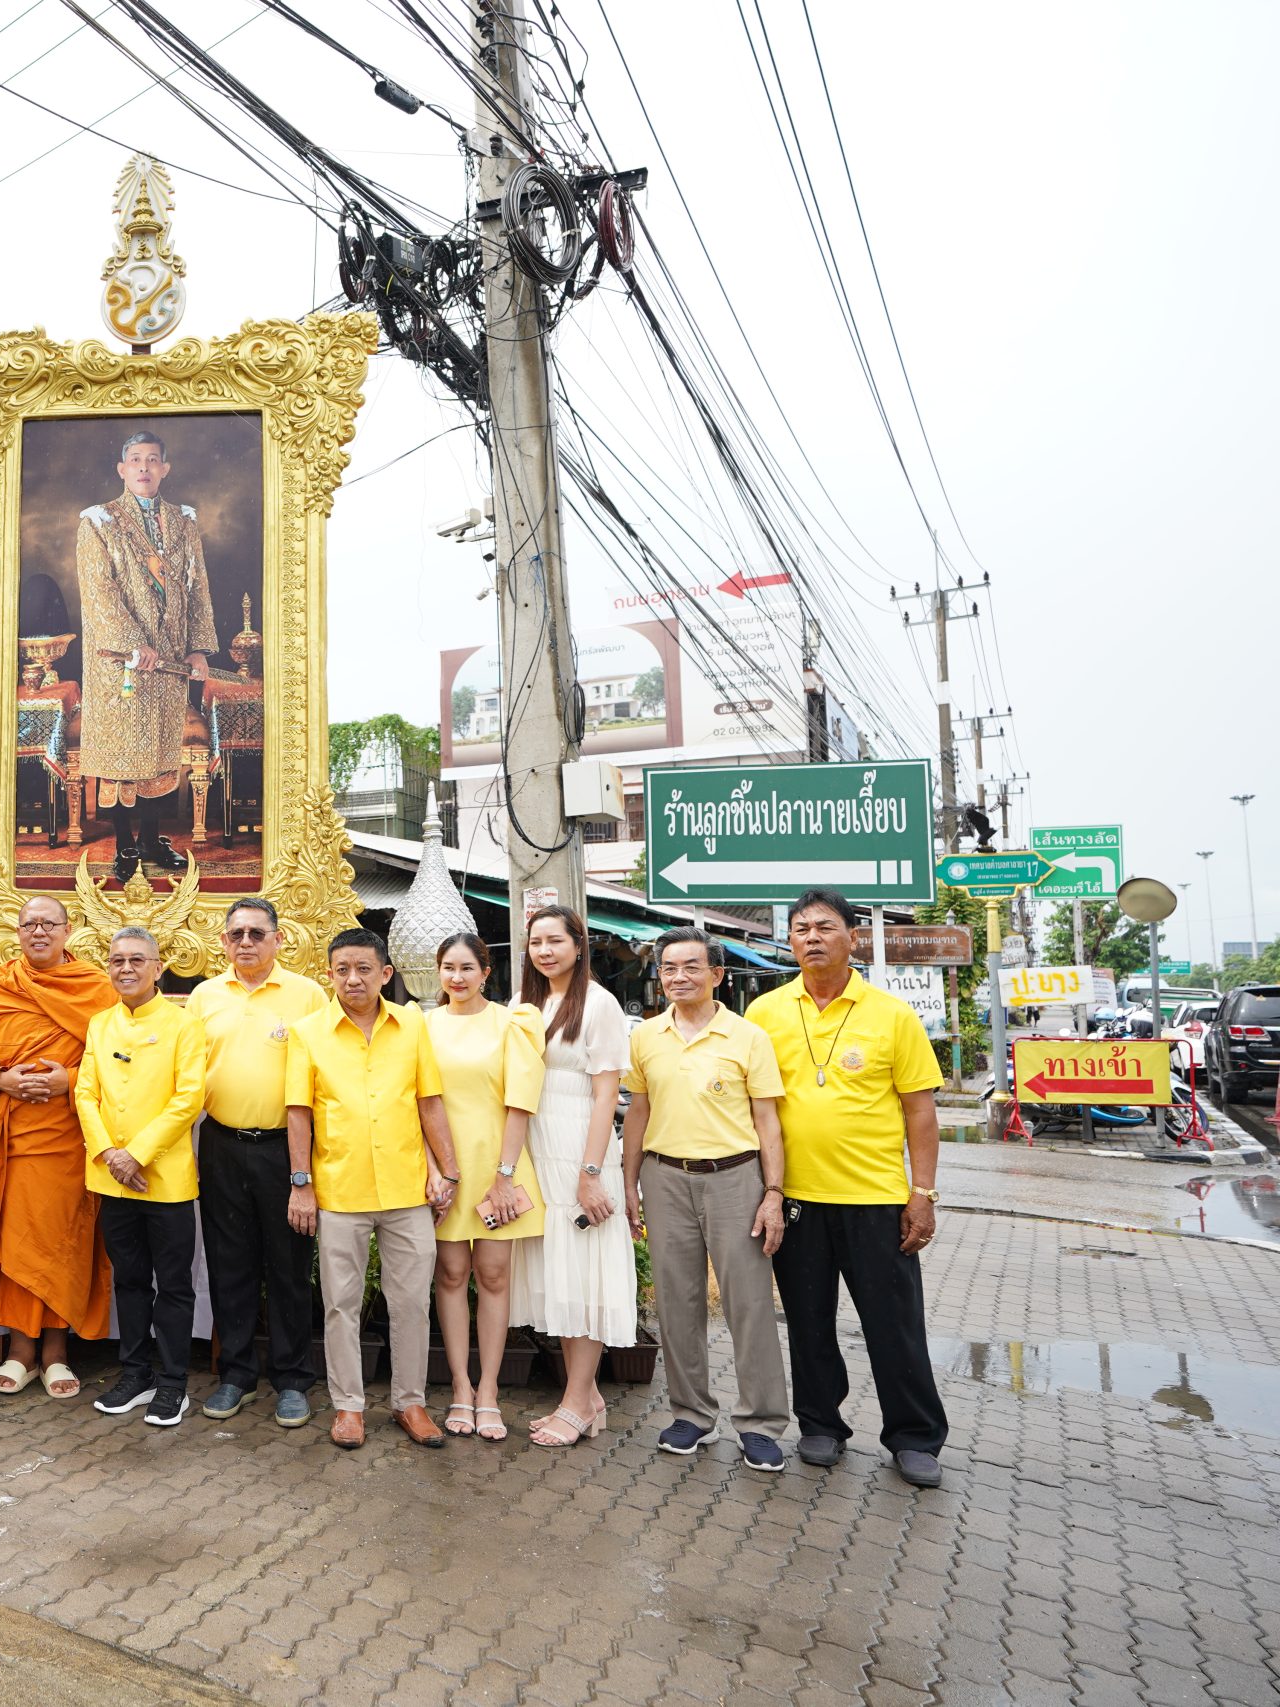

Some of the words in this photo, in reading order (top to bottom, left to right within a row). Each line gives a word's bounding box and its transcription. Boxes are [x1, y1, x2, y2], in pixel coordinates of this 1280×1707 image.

[713, 728, 726, 737] 02
[663, 770, 907, 855] ร้านลูกชิ้นปลานายเงี๊ยบ
[1034, 831, 1117, 846] เส้นทางลัด
[1026, 861, 1039, 877] 17
[858, 933, 958, 949] ชุมหน้าพุทธมณฑล
[908, 995, 942, 1011] หน่อ
[1044, 1045, 1143, 1078] ทางเข้า
